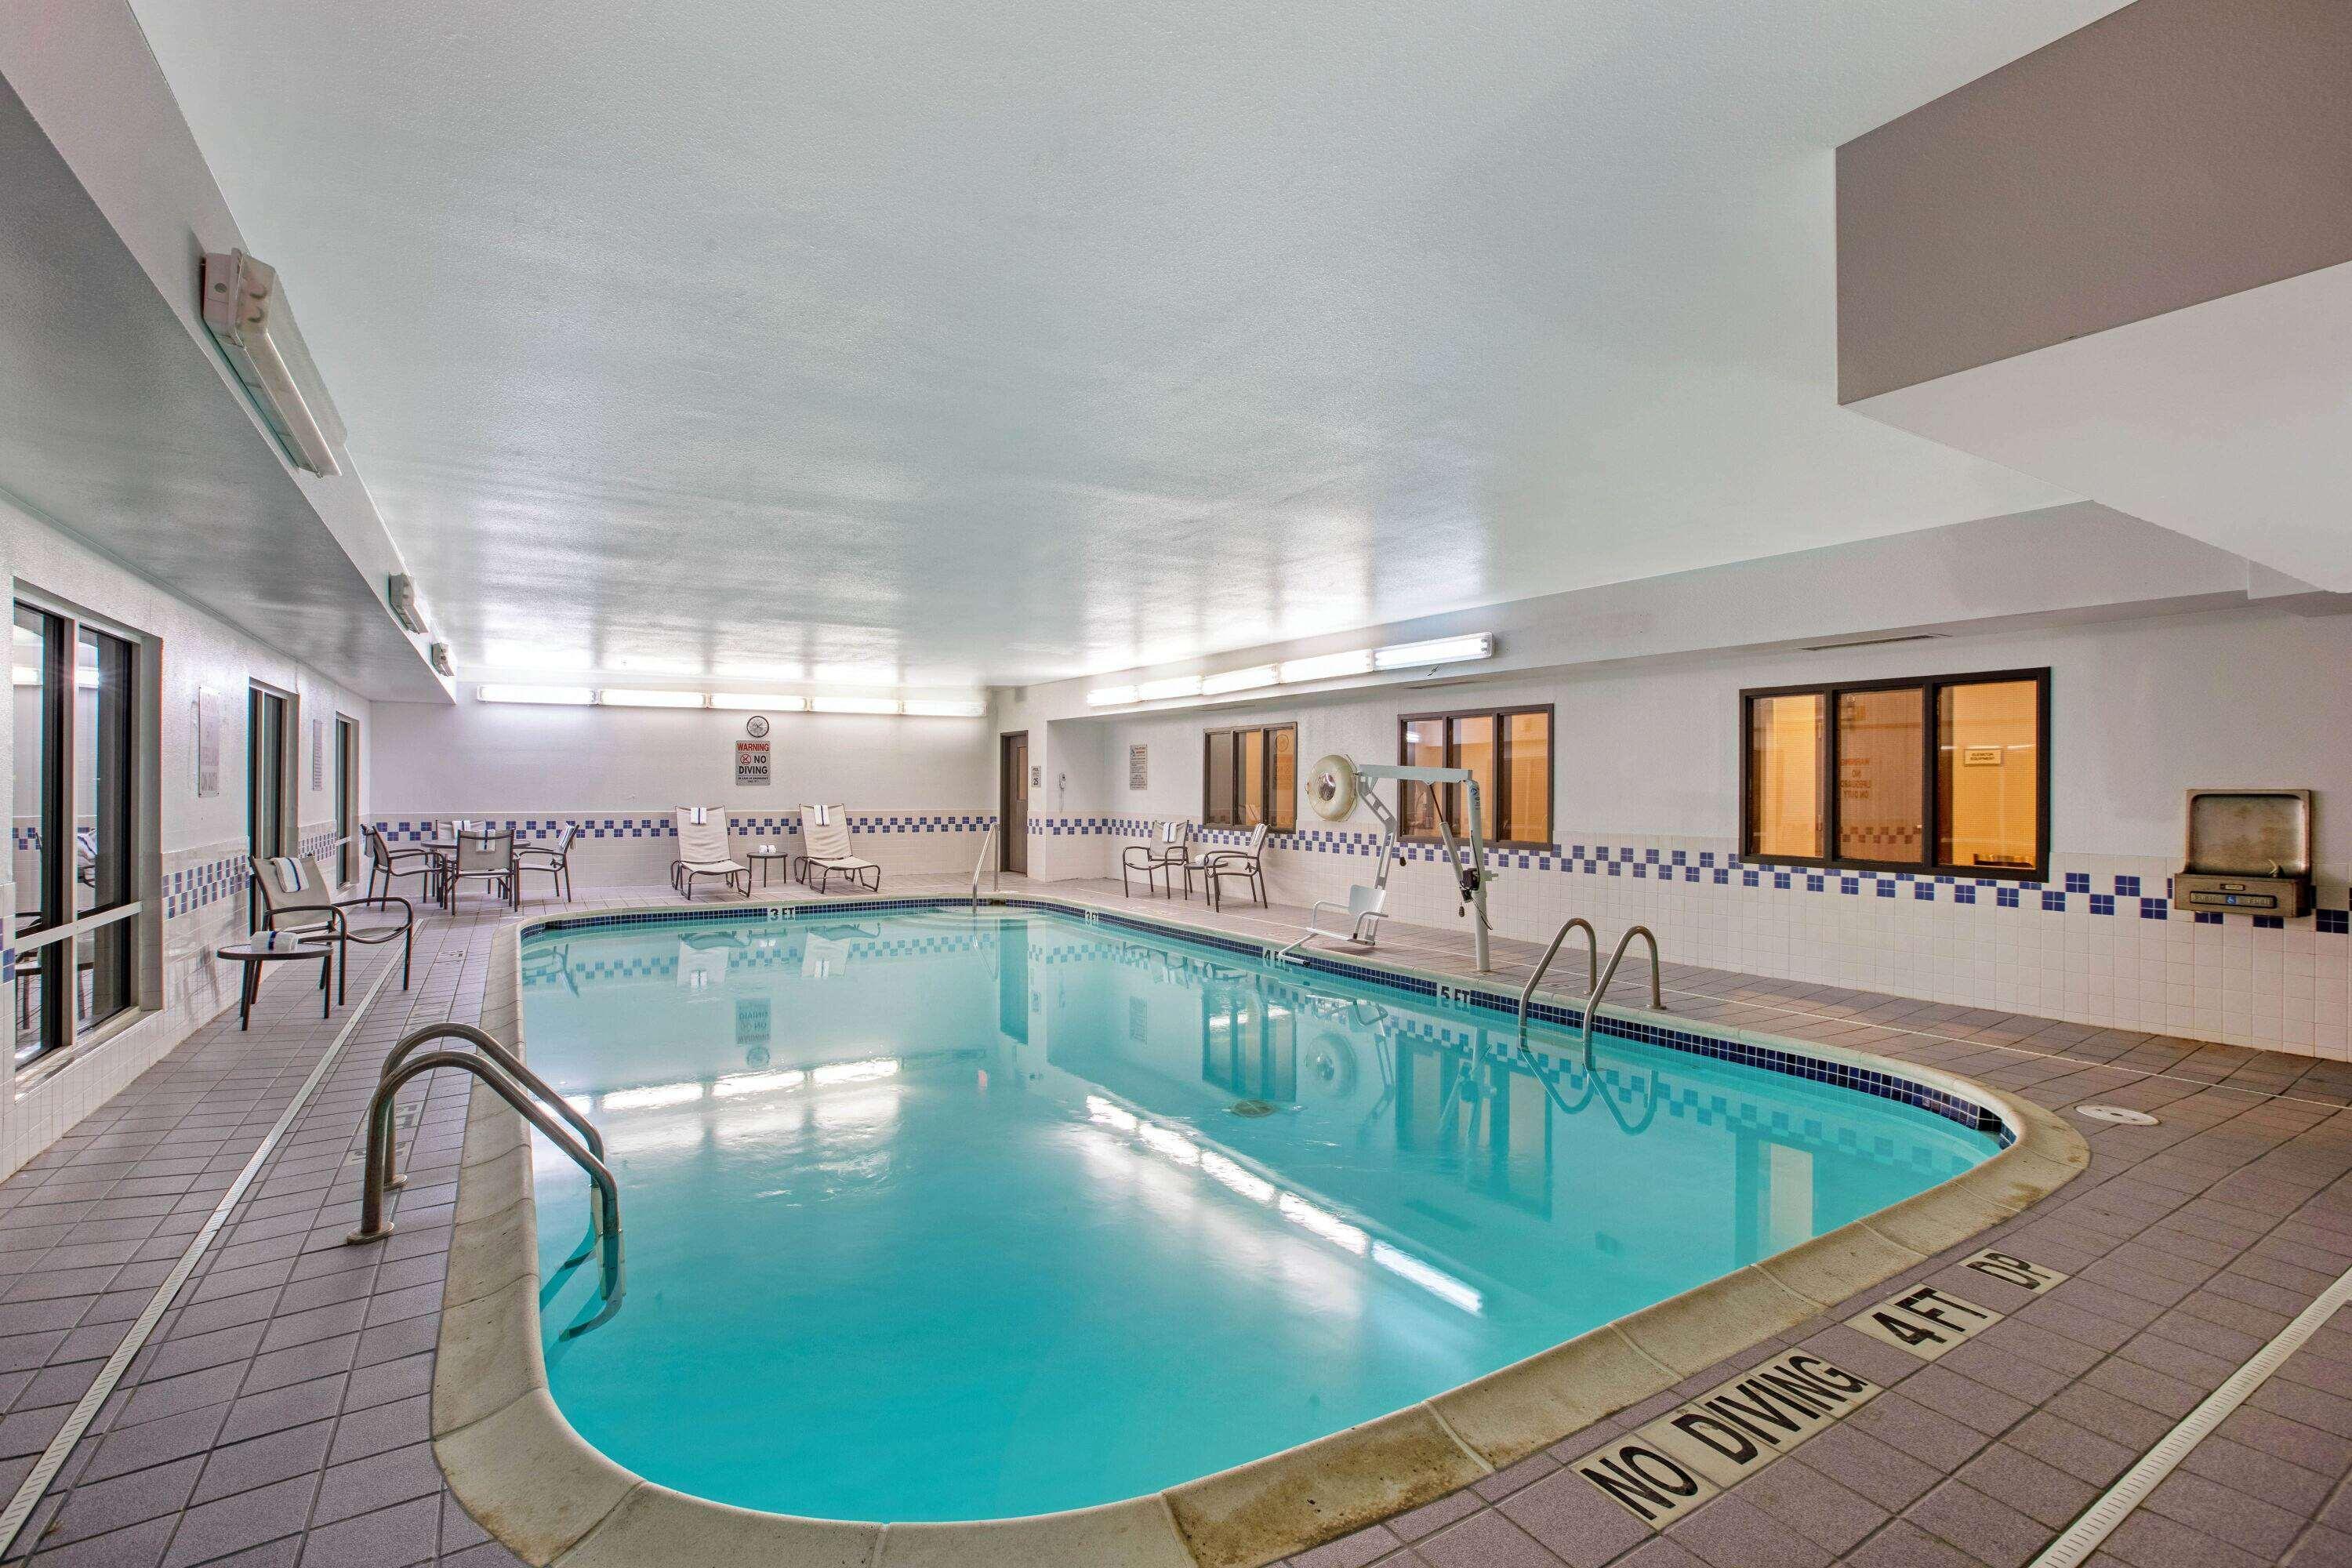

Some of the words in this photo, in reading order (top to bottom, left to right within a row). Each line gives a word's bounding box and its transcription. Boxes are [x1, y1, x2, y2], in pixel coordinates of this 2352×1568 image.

[770, 908, 779, 920] 3
[782, 907, 794, 920] FT
[1441, 985, 1450, 1004] 5
[1454, 988, 1470, 1007] FT
[1965, 1252, 2052, 1290] DP
[1579, 1446, 1699, 1521] NO
[1670, 1355, 1869, 1465] DIVING
